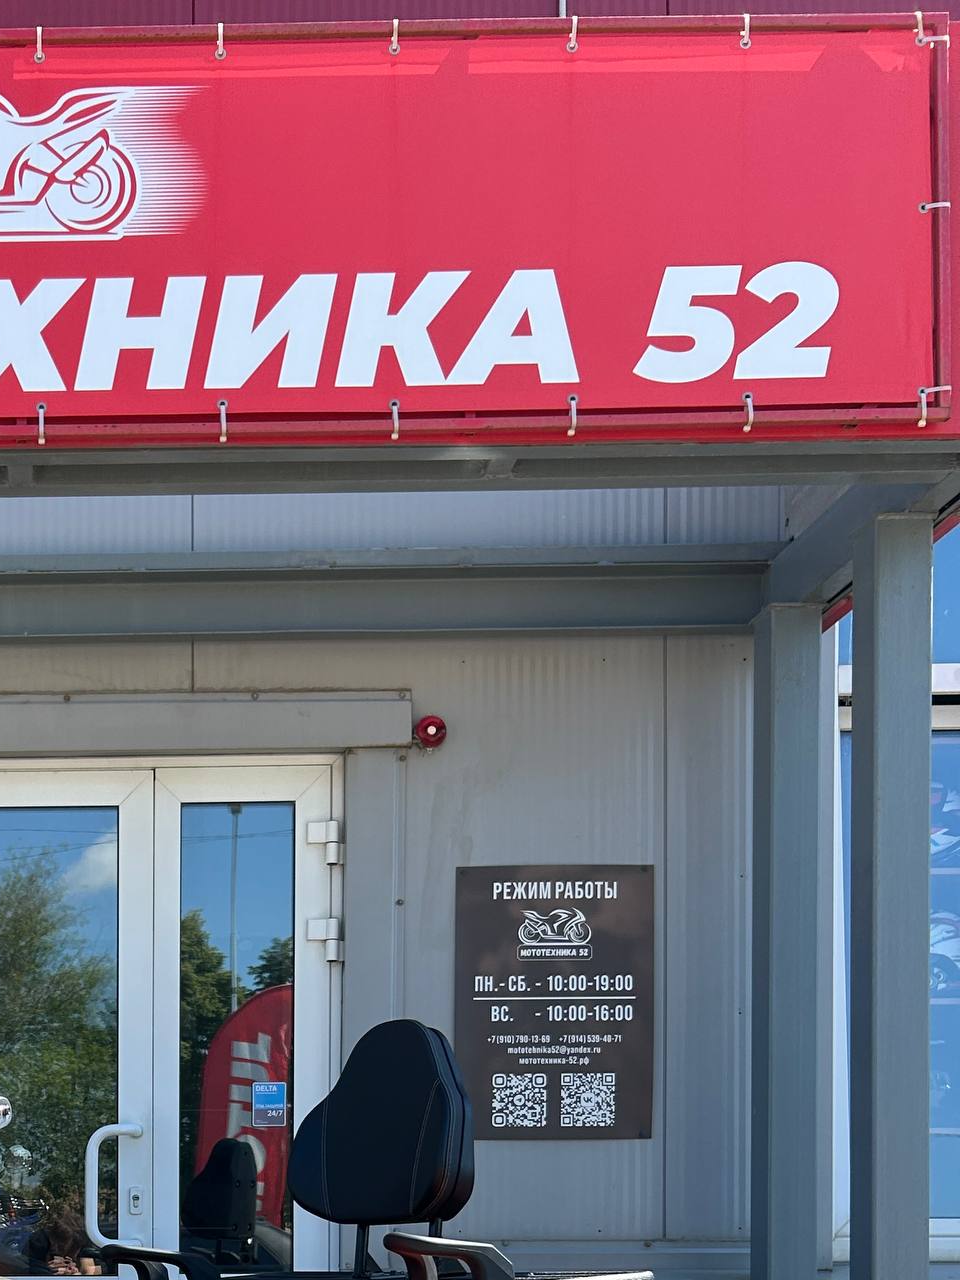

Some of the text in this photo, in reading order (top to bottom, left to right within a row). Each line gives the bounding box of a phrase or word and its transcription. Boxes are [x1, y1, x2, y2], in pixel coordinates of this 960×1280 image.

[632, 261, 840, 384] 52
[493, 881, 618, 900] РЕЖИМ РАБОТЫ
[520, 948, 589, 957] МОТОТЕХНИКА 52
[546, 974, 633, 992] 10:00-19:00
[491, 1005, 514, 1022] ВС.
[546, 1004, 633, 1022] 10:00-16:00
